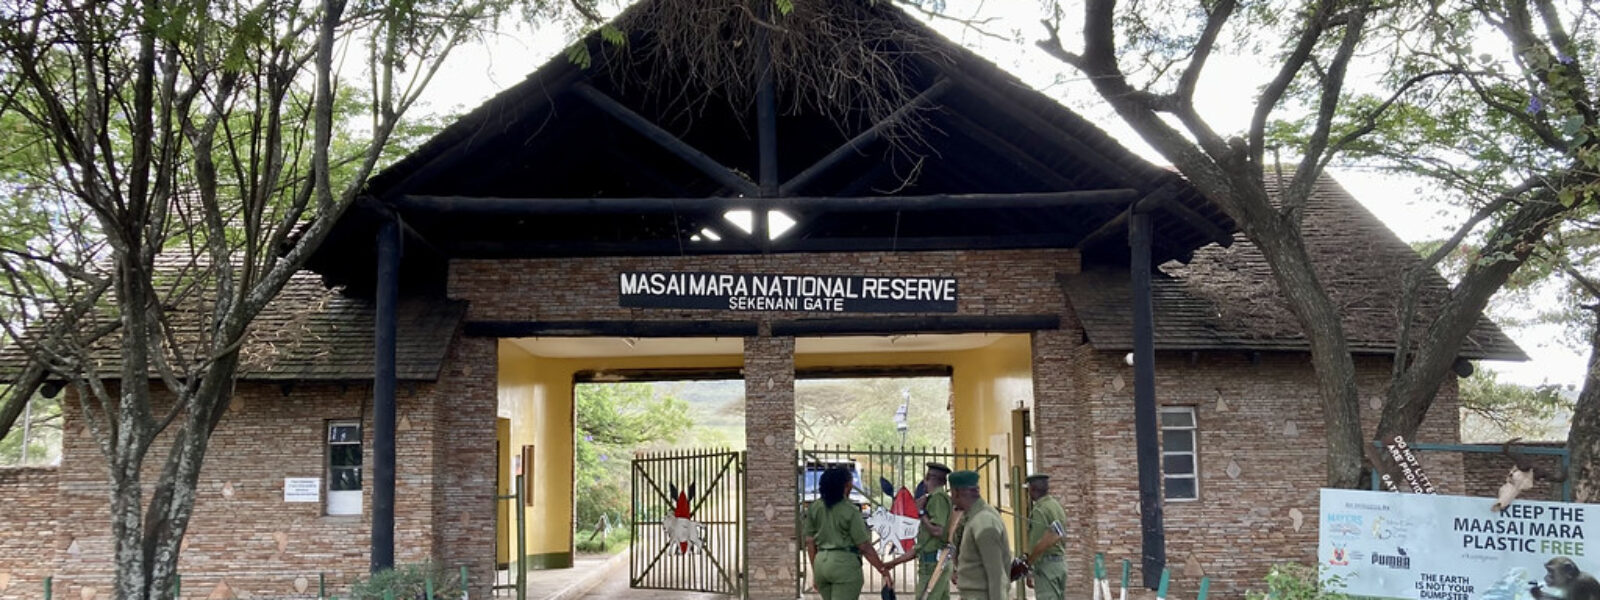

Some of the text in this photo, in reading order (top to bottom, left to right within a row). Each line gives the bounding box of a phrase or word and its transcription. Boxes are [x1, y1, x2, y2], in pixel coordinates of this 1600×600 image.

[620, 272, 956, 301] MASAI MARA NATIONAL RESERVE
[728, 296, 845, 312] SEKENANI GATE
[1387, 444, 1423, 494] ARE PROVID
[1394, 435, 1437, 495] DO NOT LITTE
[1382, 474, 1399, 493] GAT
[1500, 503, 1585, 522] KEEP THE
[1454, 517, 1584, 539] MAASAI MARA
[1463, 534, 1585, 557] PLASTIC FREE
[1415, 581, 1475, 594] IS NOT YOUR
[1420, 572, 1470, 585] THE EARTH
[1420, 590, 1470, 600] DUMPSTER
